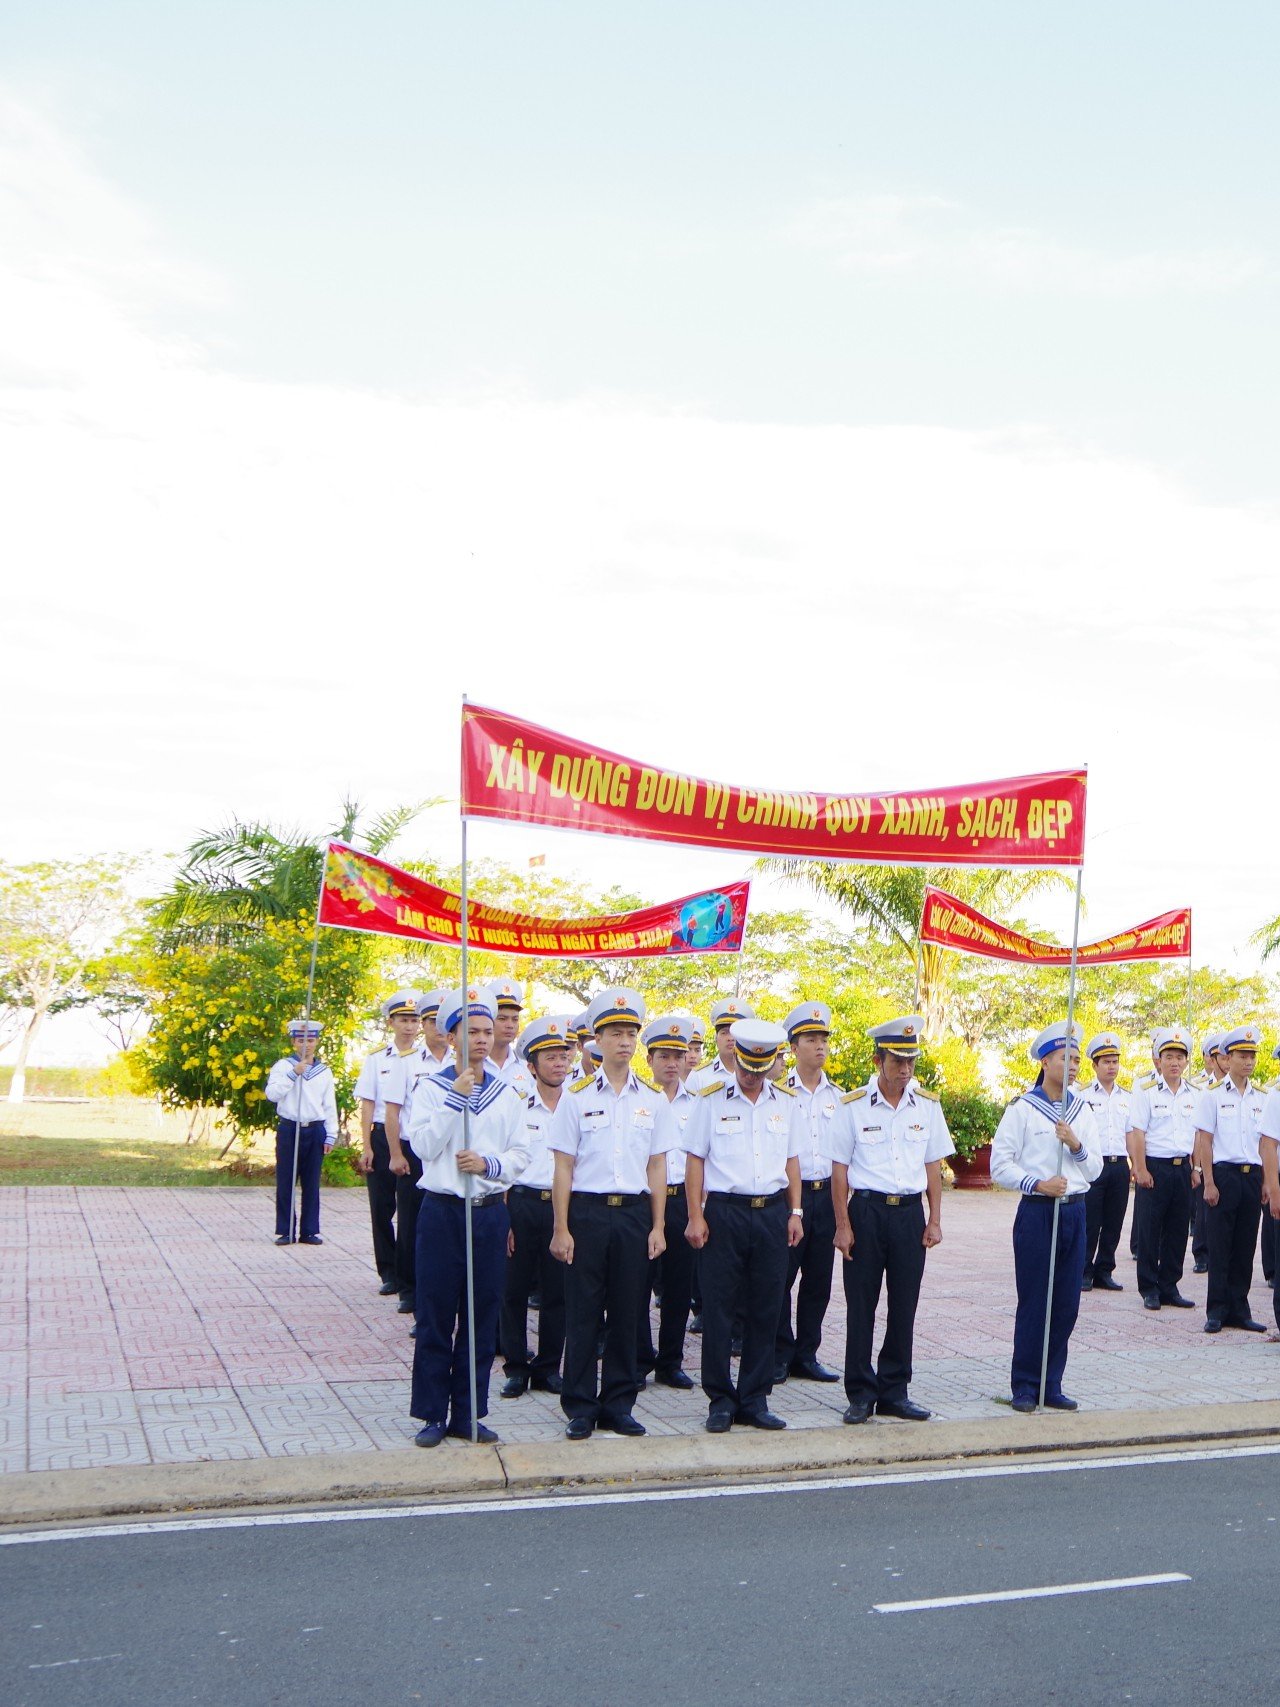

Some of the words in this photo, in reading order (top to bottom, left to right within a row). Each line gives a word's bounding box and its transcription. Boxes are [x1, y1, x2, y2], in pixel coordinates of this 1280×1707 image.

[486, 738, 545, 795] XÂY
[550, 754, 631, 811] DỰNG
[704, 779, 730, 830] VỊ
[825, 797, 871, 837] QUY
[879, 797, 949, 842] XANH,
[956, 797, 1020, 847] SẠCH,
[1027, 799, 1074, 849] ĐẸP
[396, 905, 425, 930] LÀM
[427, 915, 454, 937] CHO
[482, 927, 520, 947] NƯỚC
[560, 931, 596, 951] NGÀY
[598, 930, 636, 951] CÀNG
[637, 927, 673, 950] XUÂN
